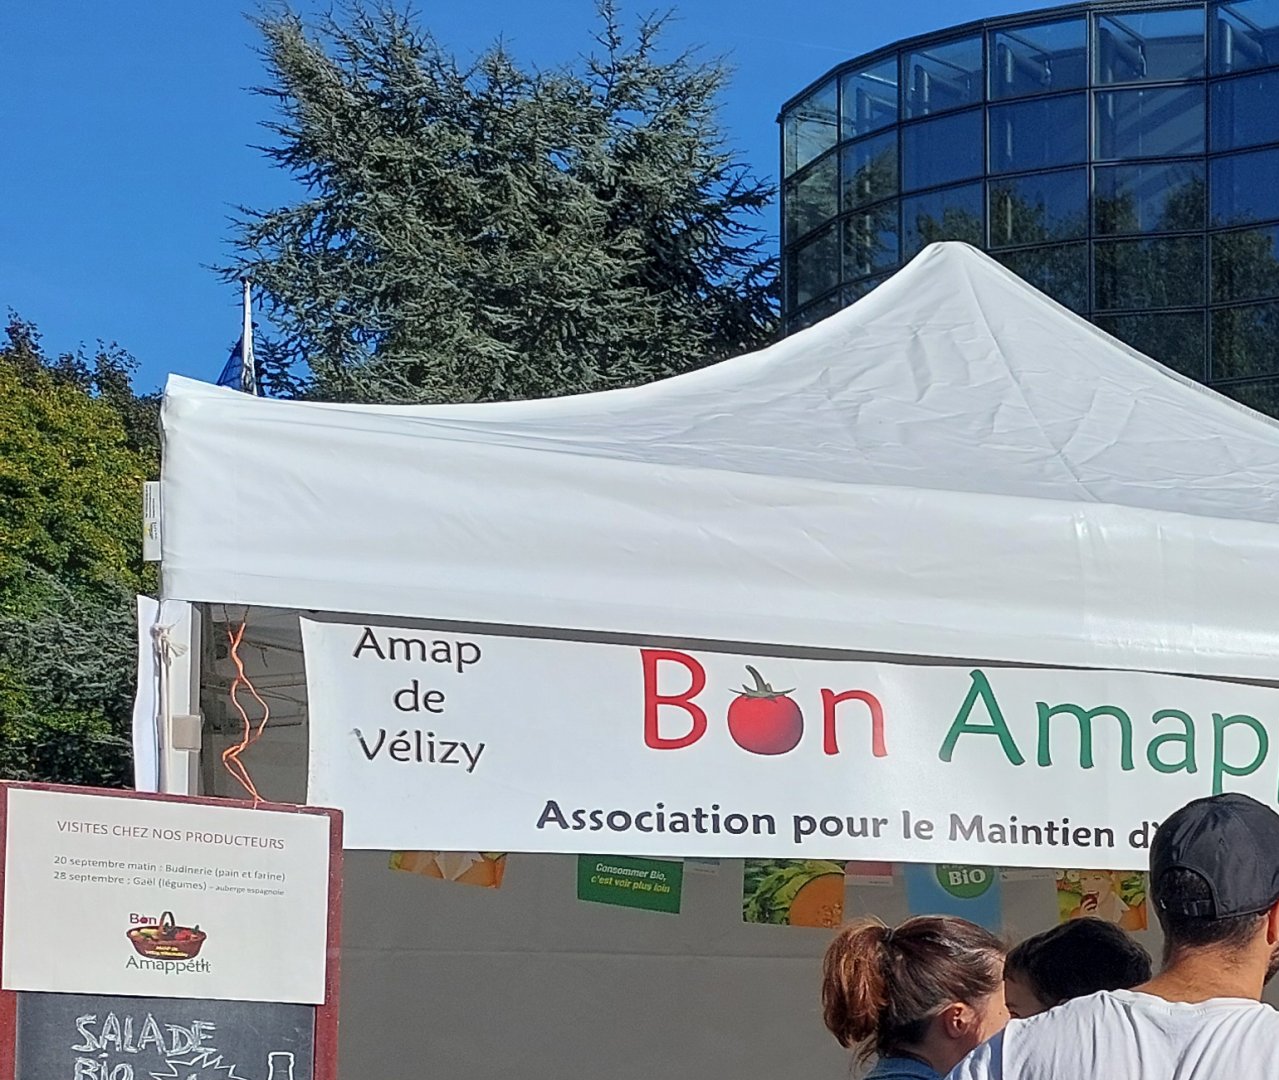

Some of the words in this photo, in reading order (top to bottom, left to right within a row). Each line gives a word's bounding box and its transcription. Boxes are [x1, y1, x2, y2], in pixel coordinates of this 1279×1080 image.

[352, 626, 481, 672] Amap
[394, 681, 446, 714] de
[352, 729, 485, 773] Vélizy
[57, 820, 108, 835] VISITES
[112, 825, 149, 838] CHEZ
[152, 828, 182, 840] NOS
[186, 830, 284, 850] PRODUCTEURS
[536, 800, 777, 835] Association
[794, 814, 888, 844] pour
[902, 810, 934, 841] le
[948, 814, 1115, 849] Maintien
[53, 871, 67, 880] 28
[69, 873, 124, 885] septembre
[158, 879, 207, 891] (légumes)
[54, 856, 67, 865] 20
[70, 858, 125, 870] septembre
[128, 861, 156, 871] matin
[215, 868, 239, 879] (pain
[242, 870, 252, 879] et
[255, 870, 285, 882] farine)
[596, 863, 648, 877] Consommer
[615, 879, 632, 887] voir
[632, 881, 651, 891] plus
[654, 883, 670, 893] loin
[71, 1011, 218, 1056] SALADE
